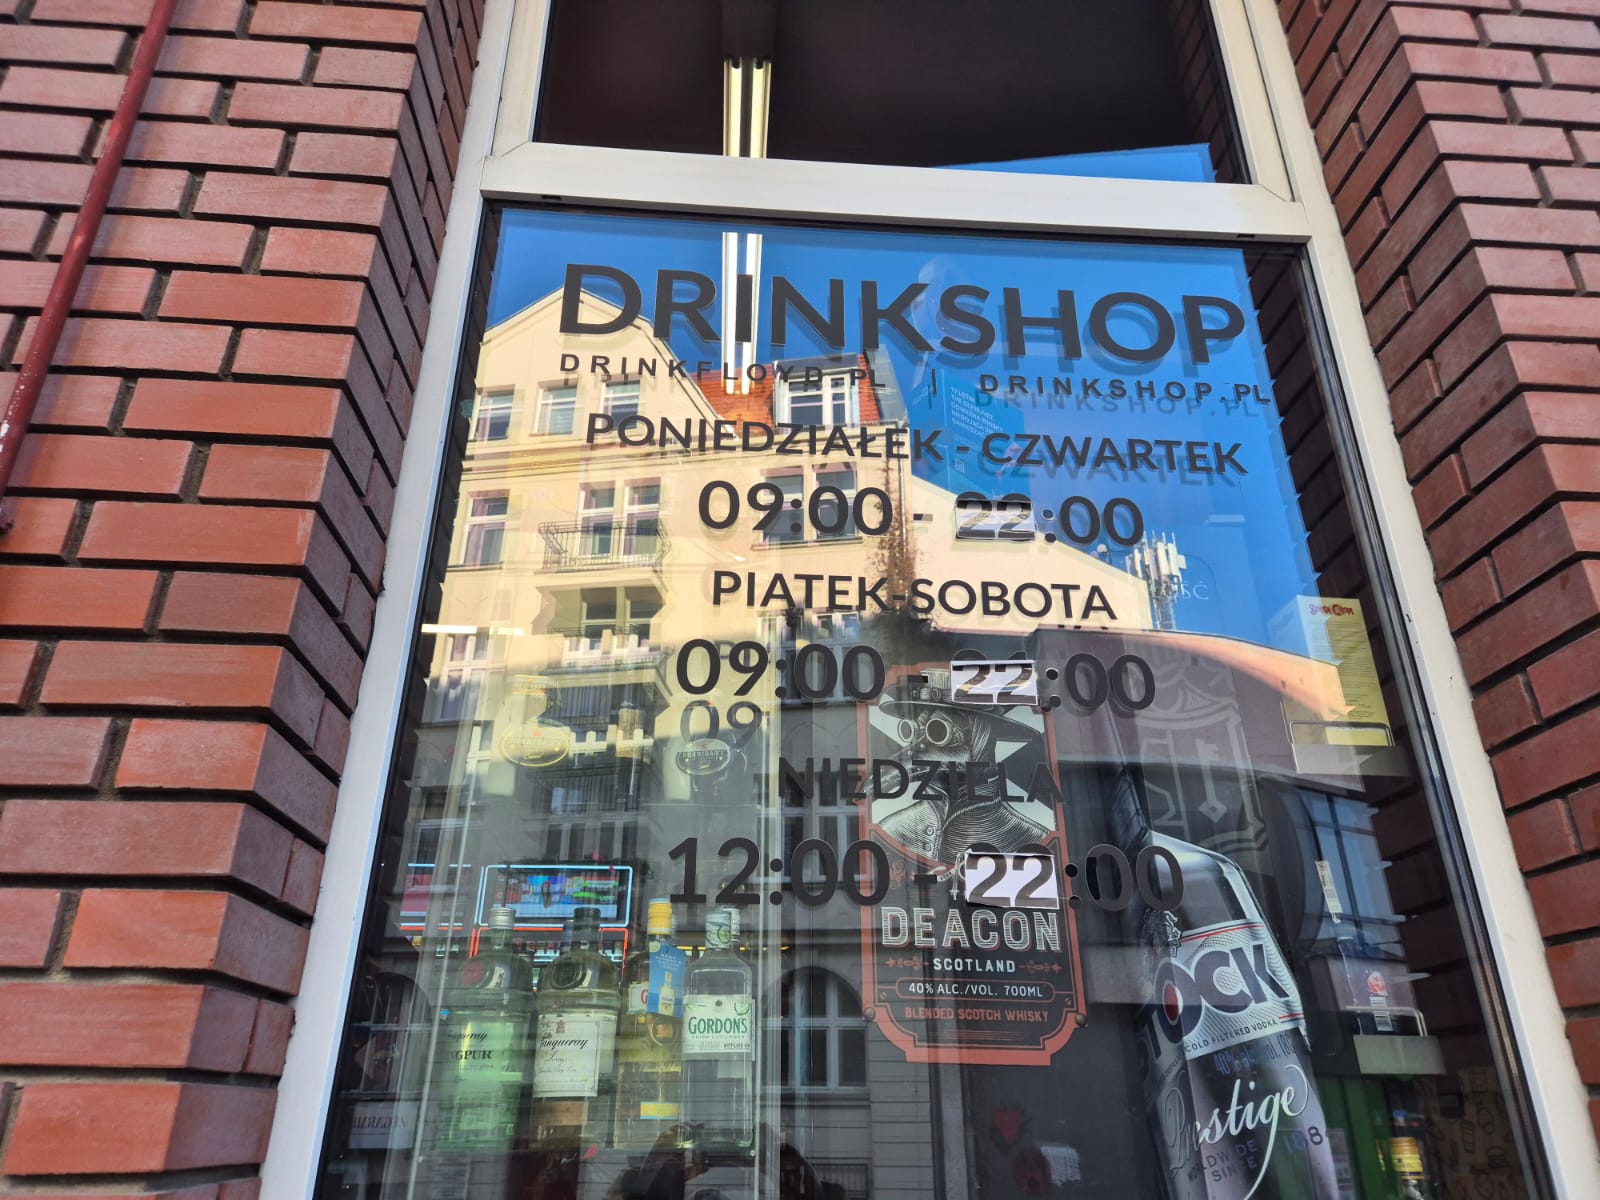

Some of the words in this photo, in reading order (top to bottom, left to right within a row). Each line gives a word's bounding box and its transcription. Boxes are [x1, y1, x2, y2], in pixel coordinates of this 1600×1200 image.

[559, 263, 1246, 365] DRINKSHOP
[980, 374, 1272, 404] DRINKSHOP.PL
[586, 412, 945, 461] PONIEDZIAŁEK
[981, 432, 1249, 474] CZWARTEK
[699, 480, 894, 536] 09:00
[955, 491, 1144, 546] 22:00
[676, 638, 886, 701] 09:00
[951, 651, 1156, 711] 22:00
[778, 757, 1064, 802] NIEDZIELA
[669, 836, 889, 905] 12:00
[964, 843, 1184, 912] 22:00
[880, 906, 1061, 951] DEACON
[932, 957, 1016, 973] SCOTLAND
[908, 982, 934, 995] 40%
[1003, 984, 1044, 998] 700ML
[904, 1006, 955, 1021] BLENDED
[957, 1007, 1002, 1022] SCOTCH
[1004, 1008, 1050, 1024] WHISKY
[1184, 1038, 1210, 1054] COLD
[1210, 1025, 1251, 1045] FILTERED
[1251, 1018, 1278, 1033] VODKA
